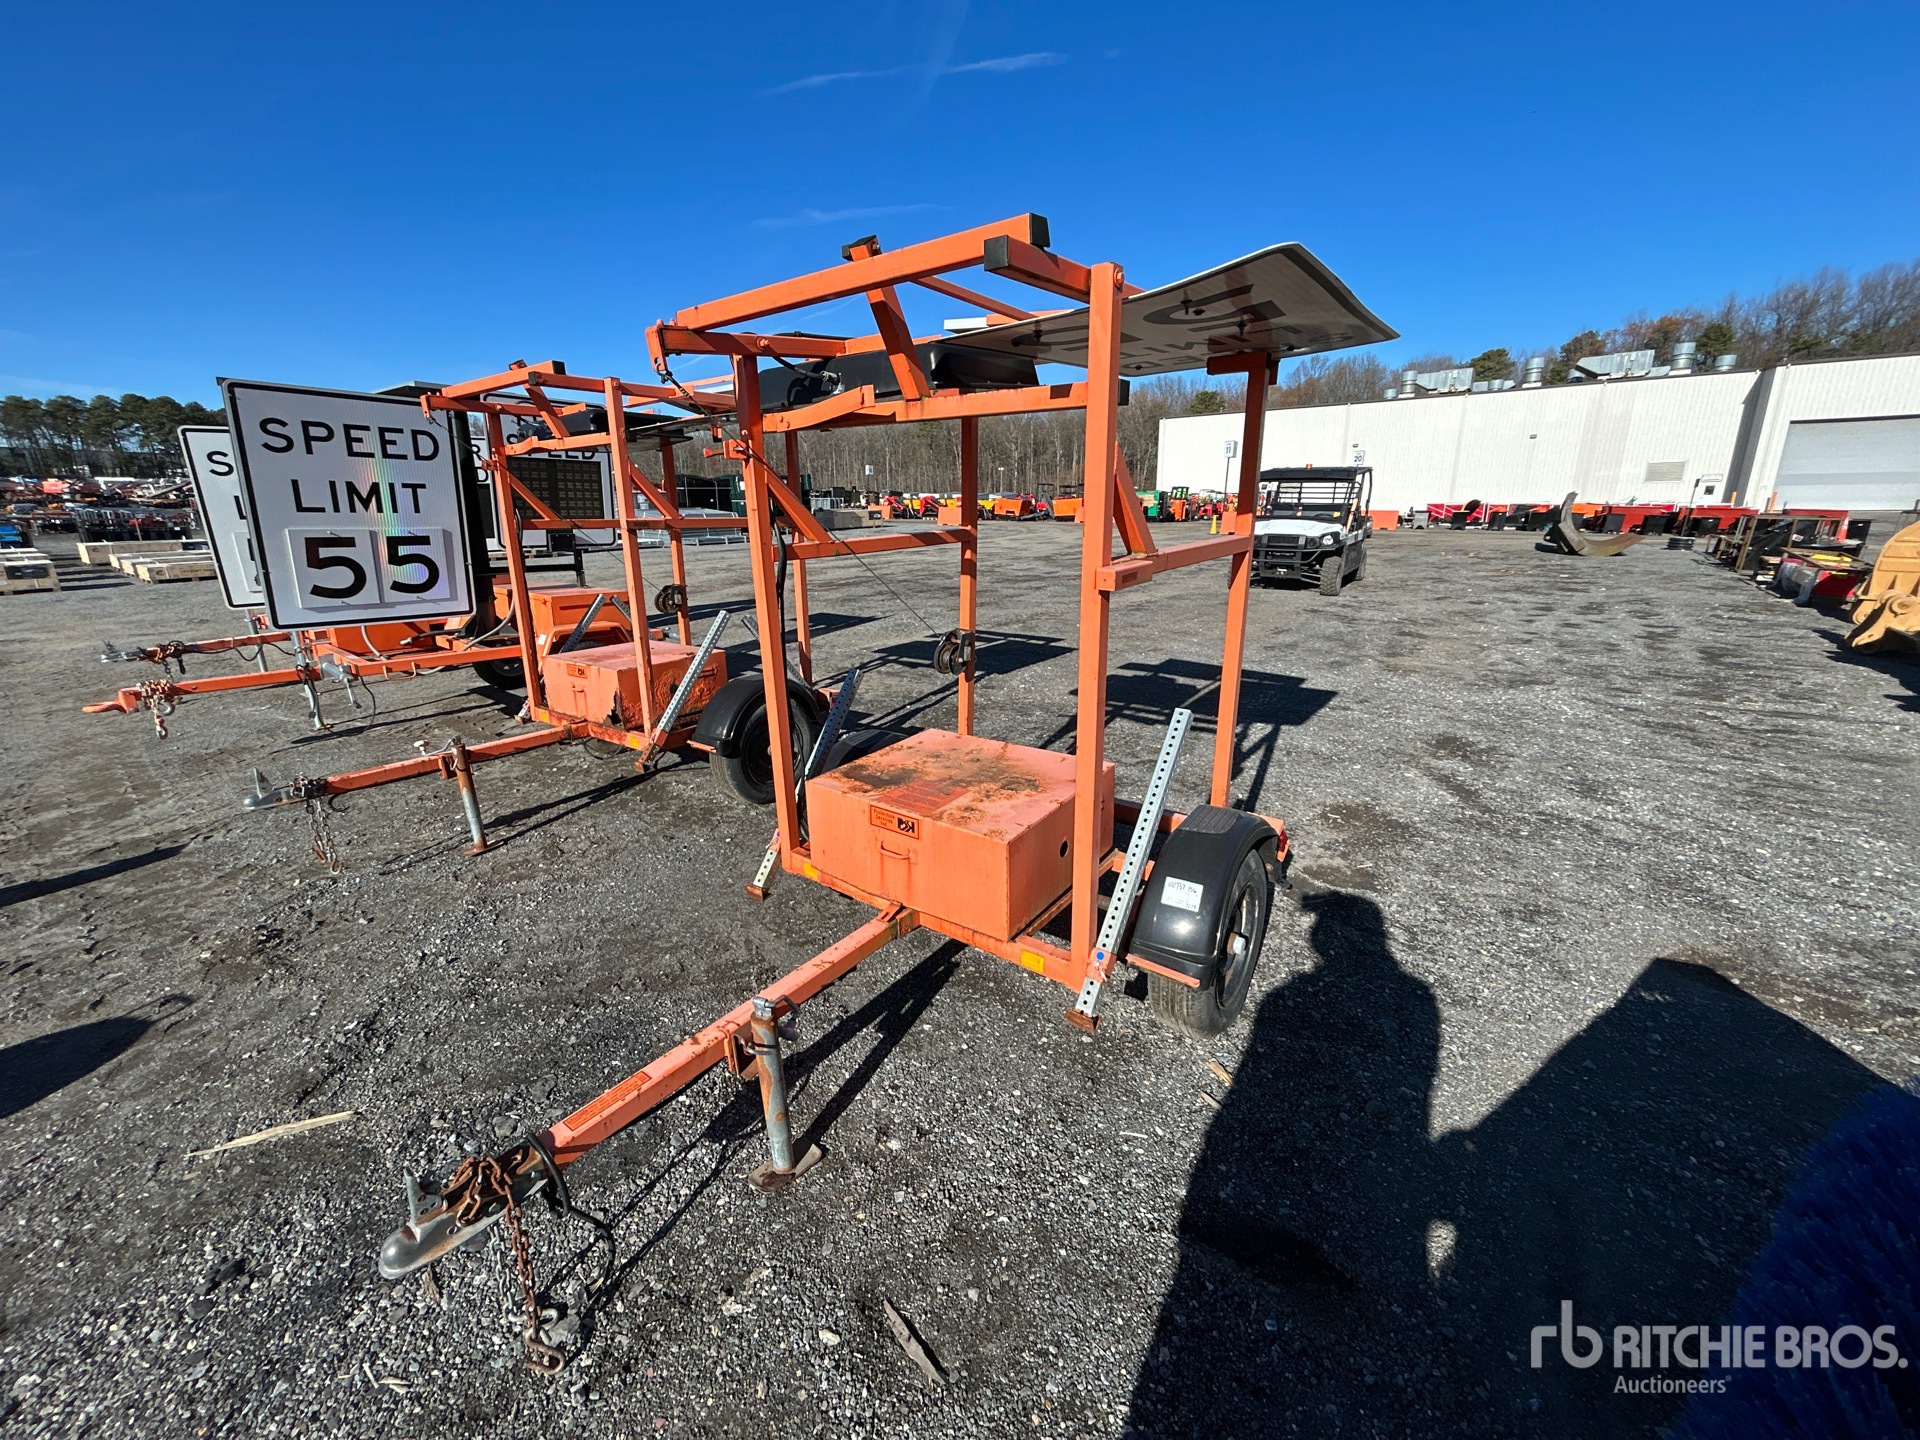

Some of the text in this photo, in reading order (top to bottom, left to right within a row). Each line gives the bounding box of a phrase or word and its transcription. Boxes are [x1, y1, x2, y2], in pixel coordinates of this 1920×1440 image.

[259, 417, 439, 461] SPEED
[1354, 455, 1363, 463] 20
[291, 479, 427, 513] LIMIT
[305, 535, 440, 598] 55
